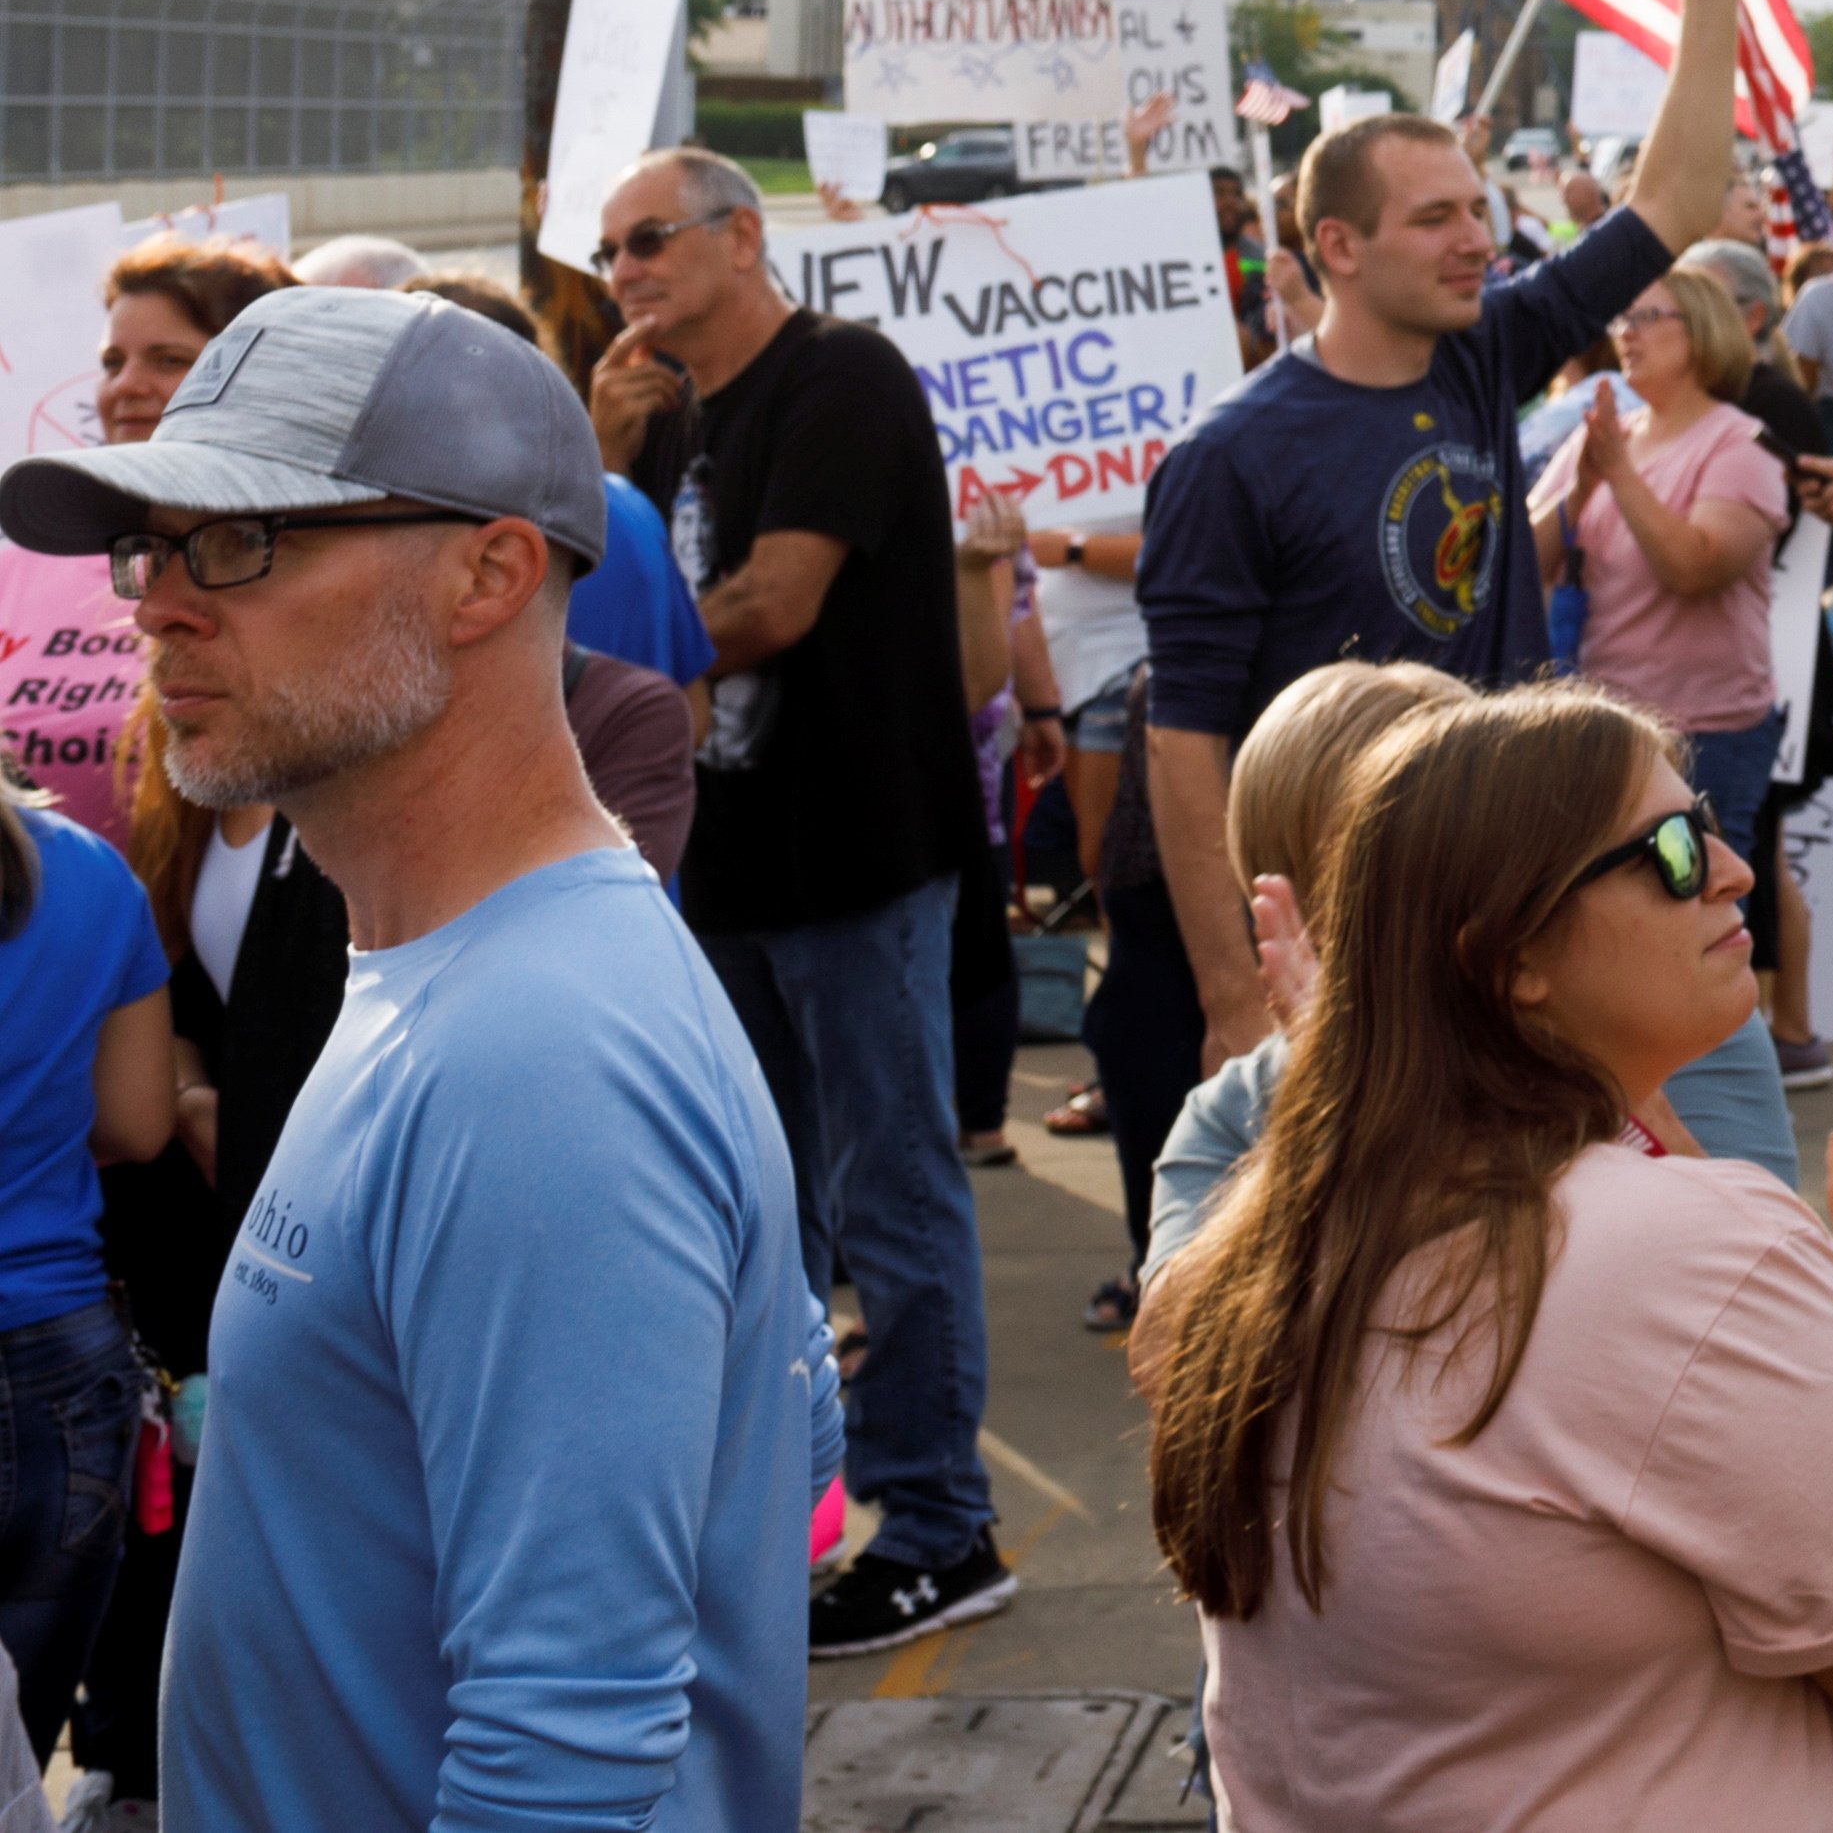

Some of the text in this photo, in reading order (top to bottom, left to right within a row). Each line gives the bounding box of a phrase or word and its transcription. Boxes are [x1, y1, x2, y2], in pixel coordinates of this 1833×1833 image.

[1026, 121, 1225, 167] FREEOM
[943, 260, 1220, 338] VACCINE:
[916, 330, 1118, 411] NETIC
[939, 372, 1196, 466] DANGER!
[0, 629, 30, 662] y
[247, 1188, 309, 1260] ohio
